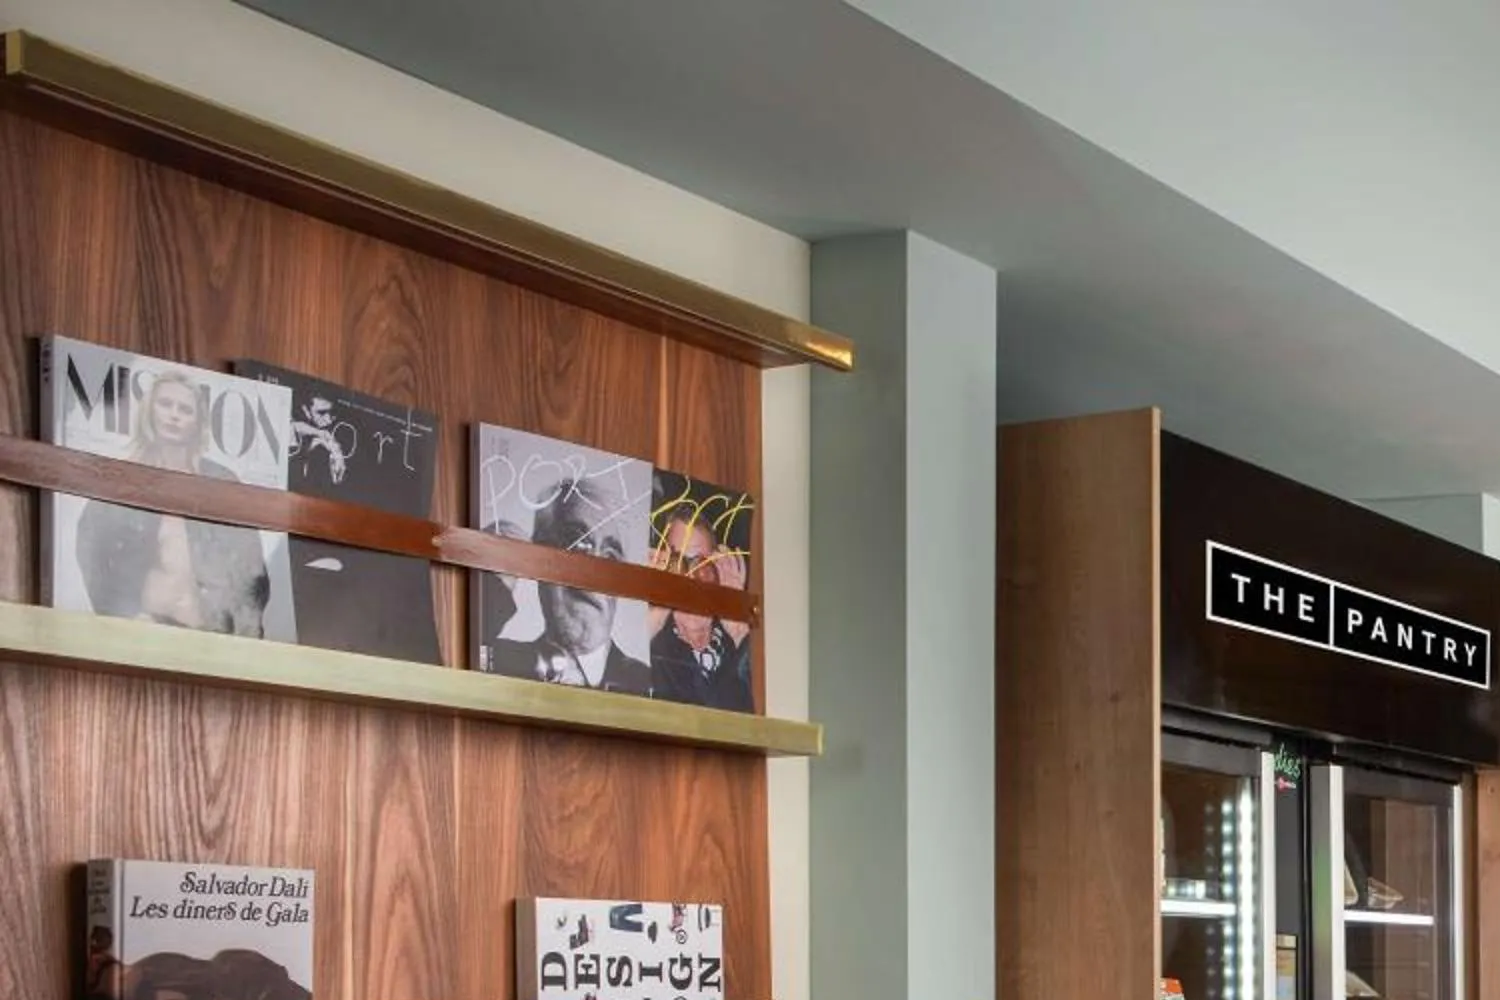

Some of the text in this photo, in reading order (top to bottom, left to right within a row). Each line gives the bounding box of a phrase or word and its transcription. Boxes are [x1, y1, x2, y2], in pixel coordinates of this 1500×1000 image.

[1231, 573, 1477, 667] THE PANTRY
[179, 871, 268, 897] Salvador
[129, 896, 168, 919] Les
[240, 902, 263, 921] de
[265, 901, 309, 928] Gala
[541, 951, 721, 993] DESIGN
